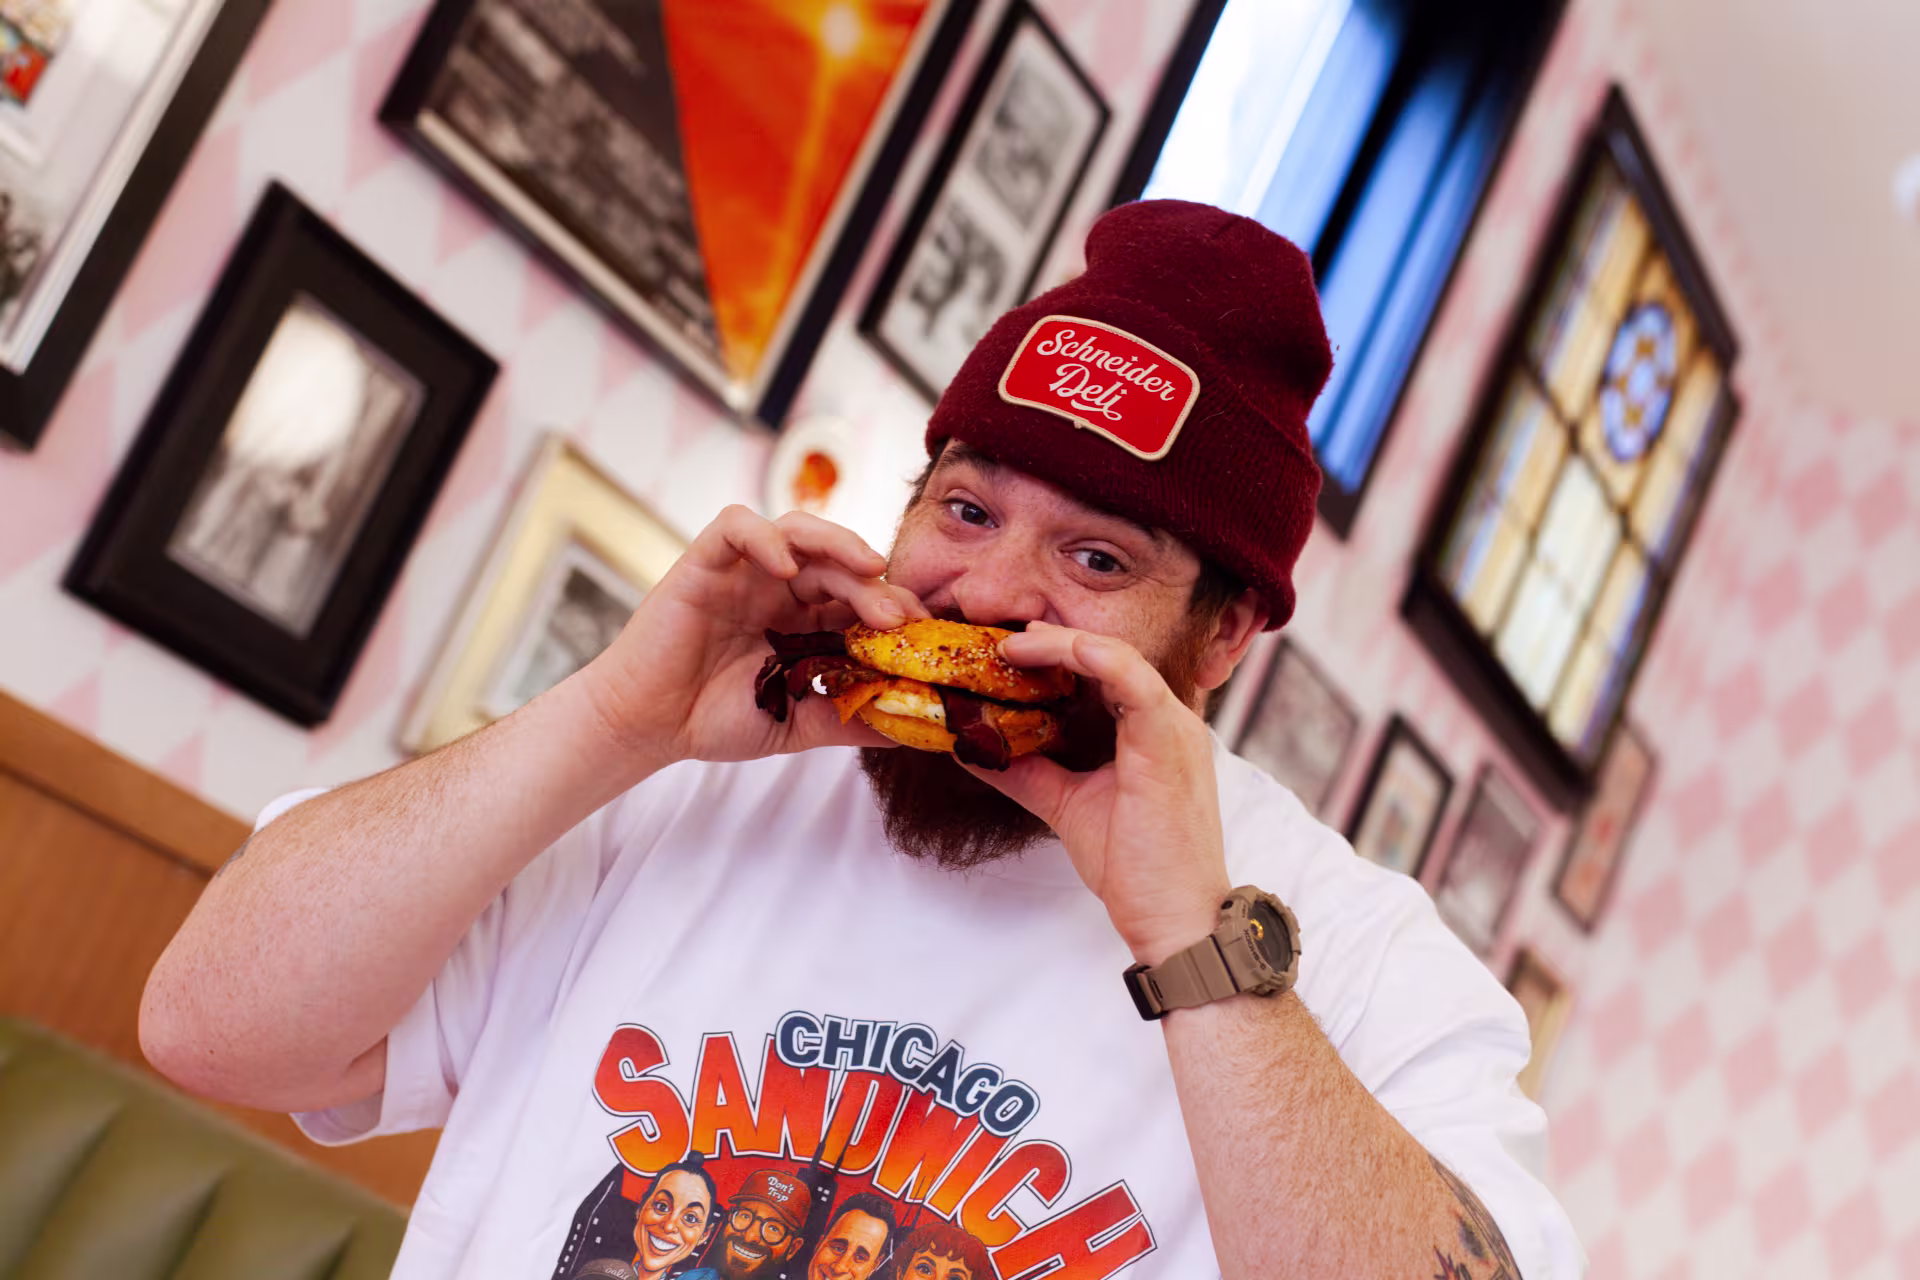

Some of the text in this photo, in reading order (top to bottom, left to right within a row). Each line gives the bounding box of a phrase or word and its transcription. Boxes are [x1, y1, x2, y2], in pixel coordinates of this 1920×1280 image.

[1036, 329, 1176, 401] Schneider
[1049, 363, 1128, 421] Deli
[775, 1010, 1040, 1137] CHICAGO
[592, 1022, 1158, 1280] SANDWICH
[767, 1176, 795, 1194] Don't
[767, 1186, 789, 1202] Trip
